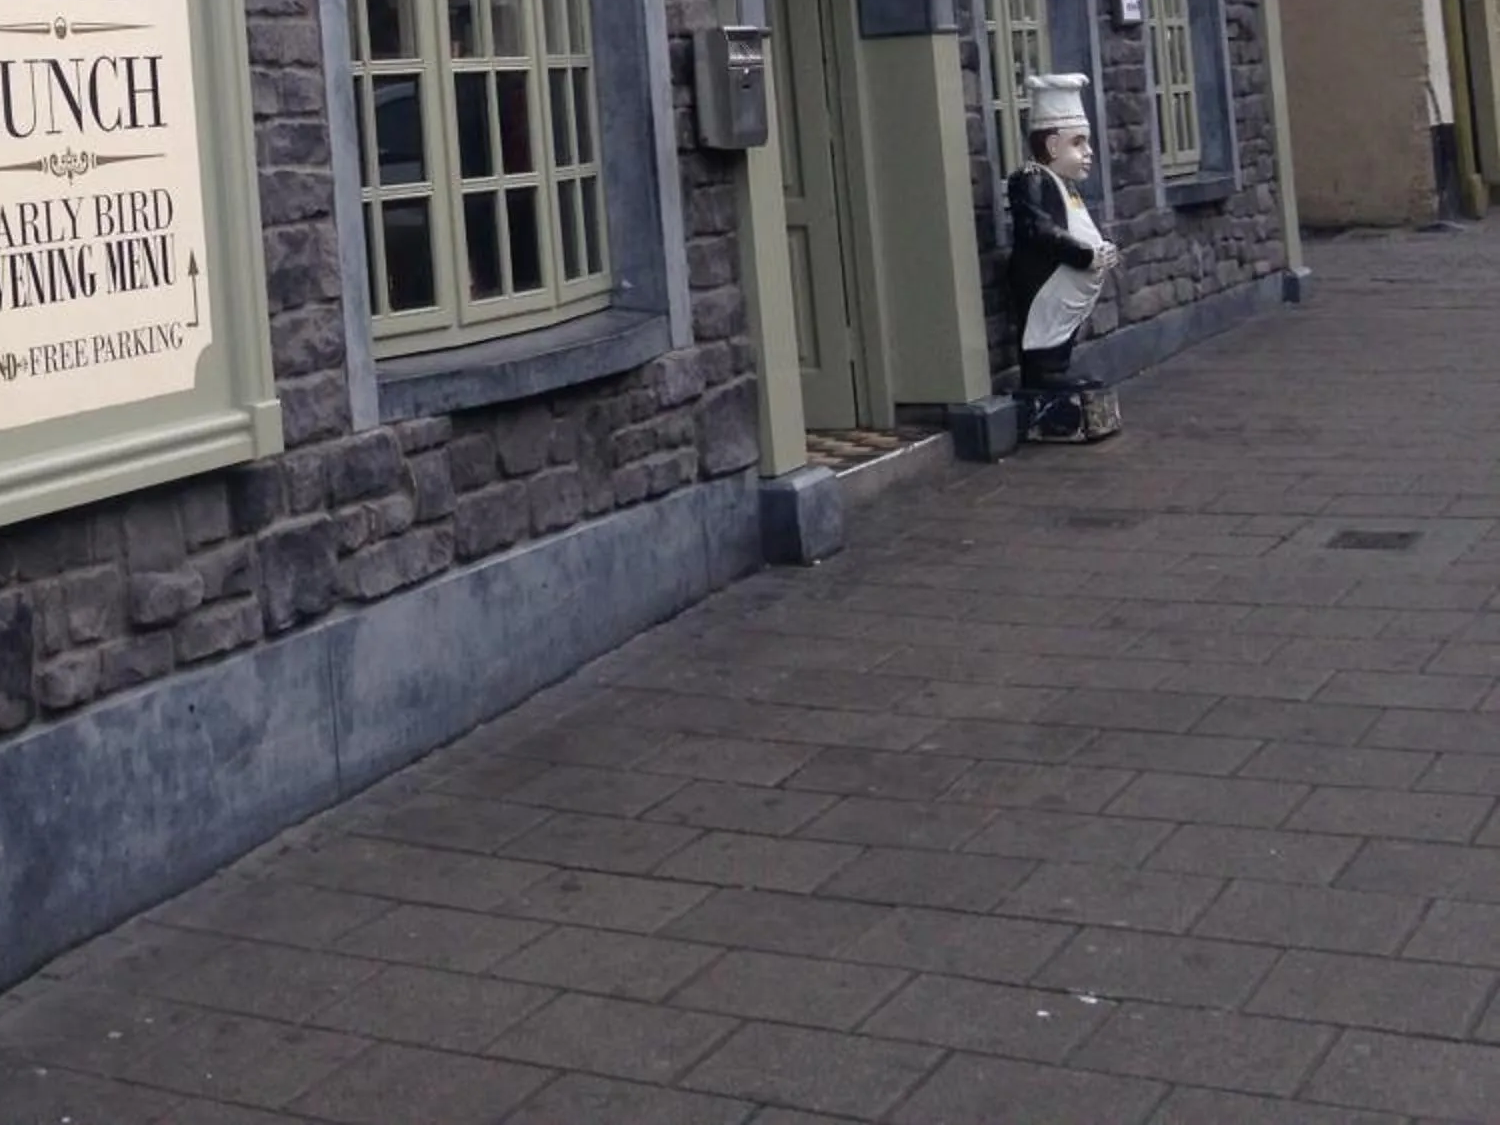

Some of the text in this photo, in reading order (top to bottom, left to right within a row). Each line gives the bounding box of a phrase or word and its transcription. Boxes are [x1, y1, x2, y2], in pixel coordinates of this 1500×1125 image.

[92, 188, 174, 237] BIRD
[104, 233, 176, 294] MENU
[28, 334, 89, 377] FREE
[92, 321, 184, 364] PARKING
